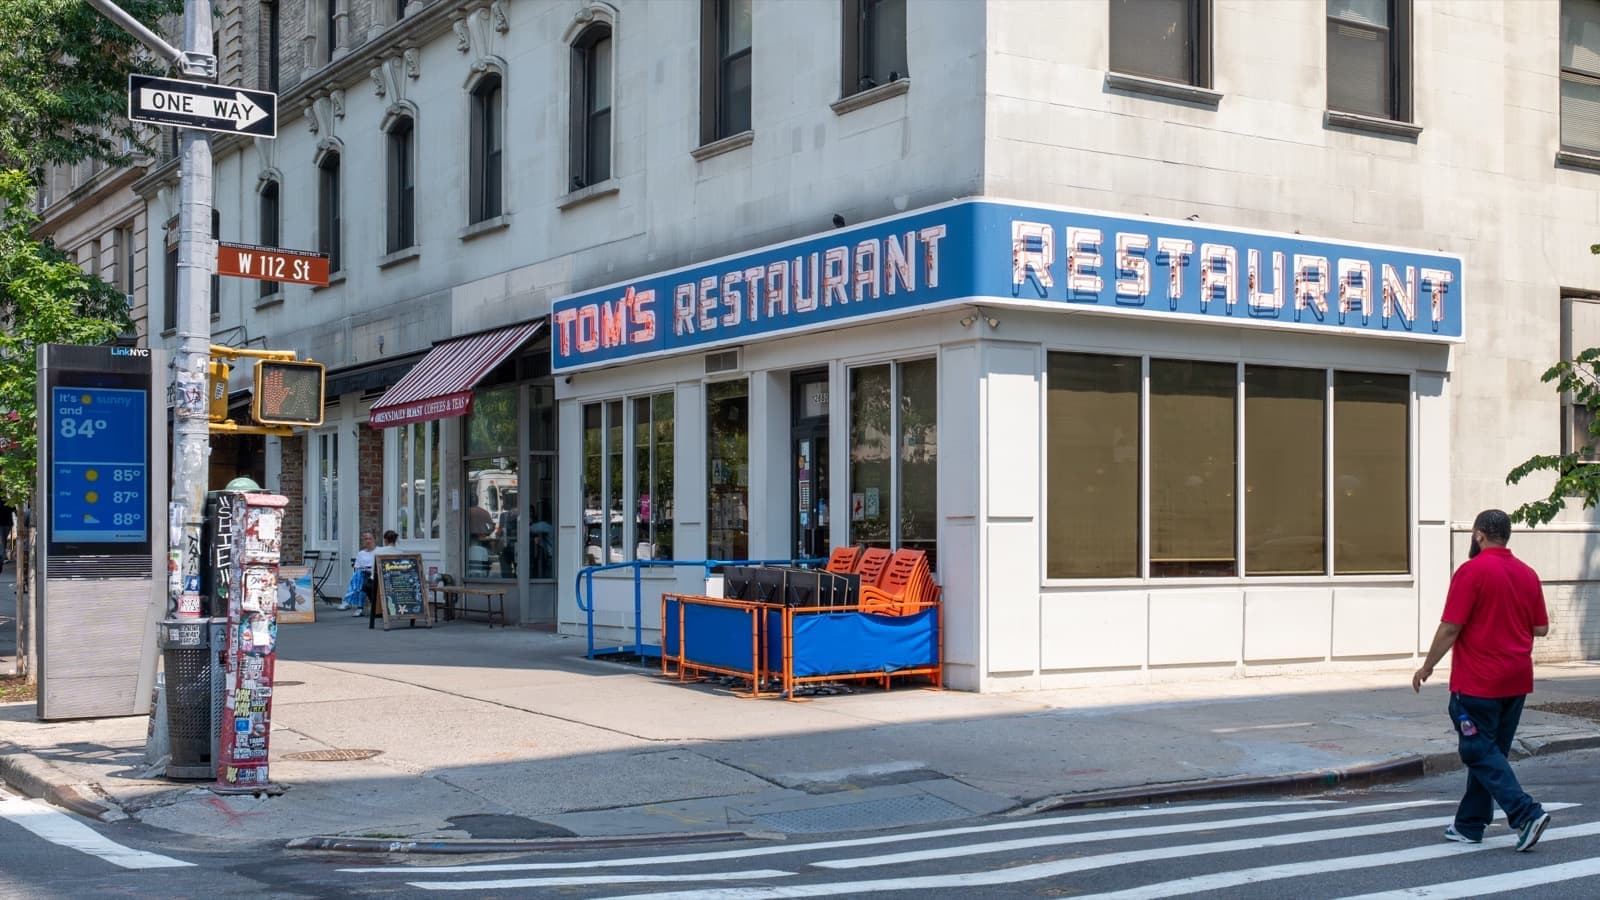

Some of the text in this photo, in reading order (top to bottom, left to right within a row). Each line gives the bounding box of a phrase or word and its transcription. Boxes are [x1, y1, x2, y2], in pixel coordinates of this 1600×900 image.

[152, 92, 194, 113] ONE
[213, 100, 254, 120] WAY
[239, 253, 310, 280] W 112 St
[1011, 220, 1454, 328] RESTAURANT
[554, 224, 947, 357] TOM'S RESTAURANT
[111, 346, 149, 357] LinkNYC
[59, 393, 77, 403] It's
[452, 398, 465, 410] TEAS
[59, 406, 83, 415] and
[60, 417, 107, 438] 84°
[113, 469, 141, 482] 85°
[113, 490, 139, 504] 87°
[113, 512, 141, 526] 88°
